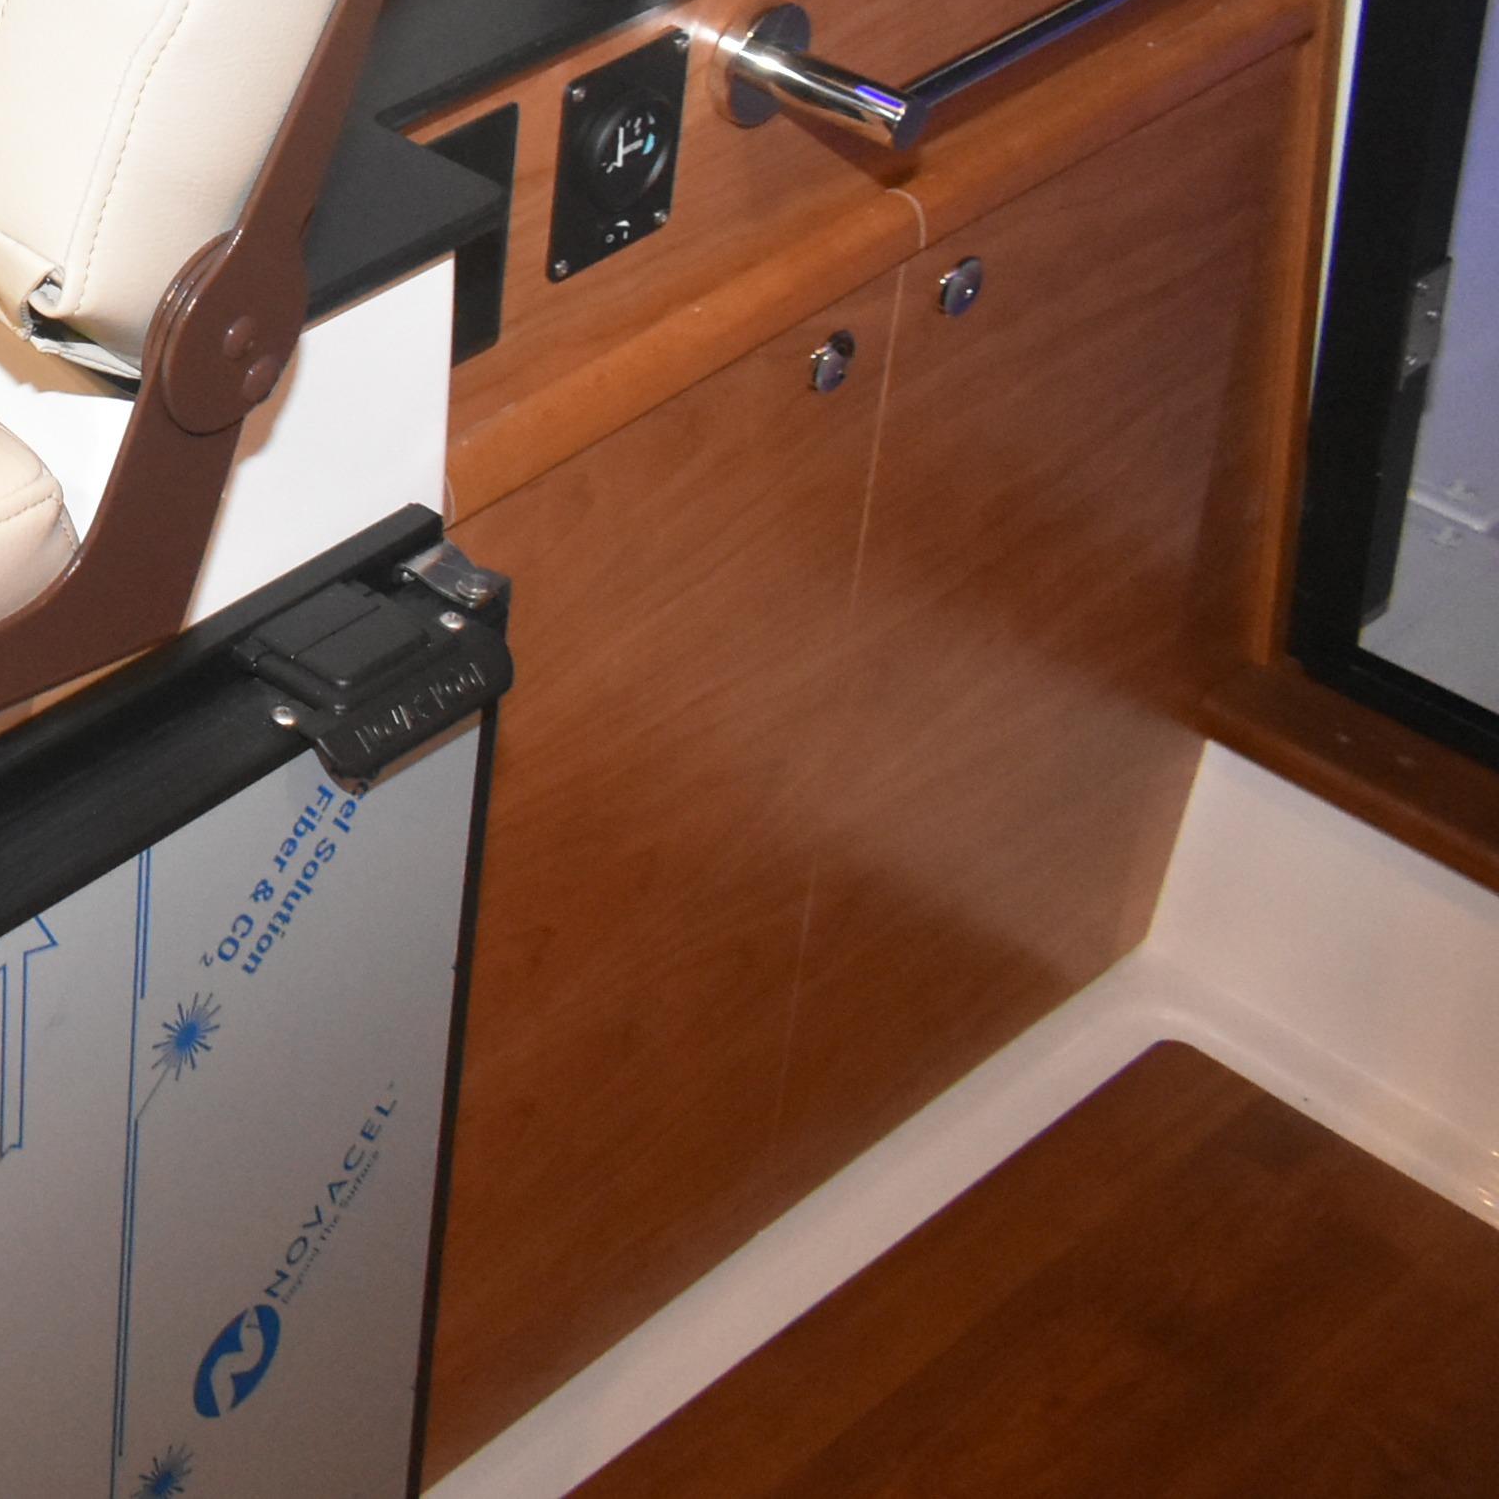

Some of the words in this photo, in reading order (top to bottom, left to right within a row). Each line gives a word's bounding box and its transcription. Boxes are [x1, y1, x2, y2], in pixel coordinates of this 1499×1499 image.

[273, 784, 335, 872] Fiber
[241, 837, 336, 974] Solution
[250, 879, 274, 903] &
[265, 1099, 397, 1298] NOVACEL
